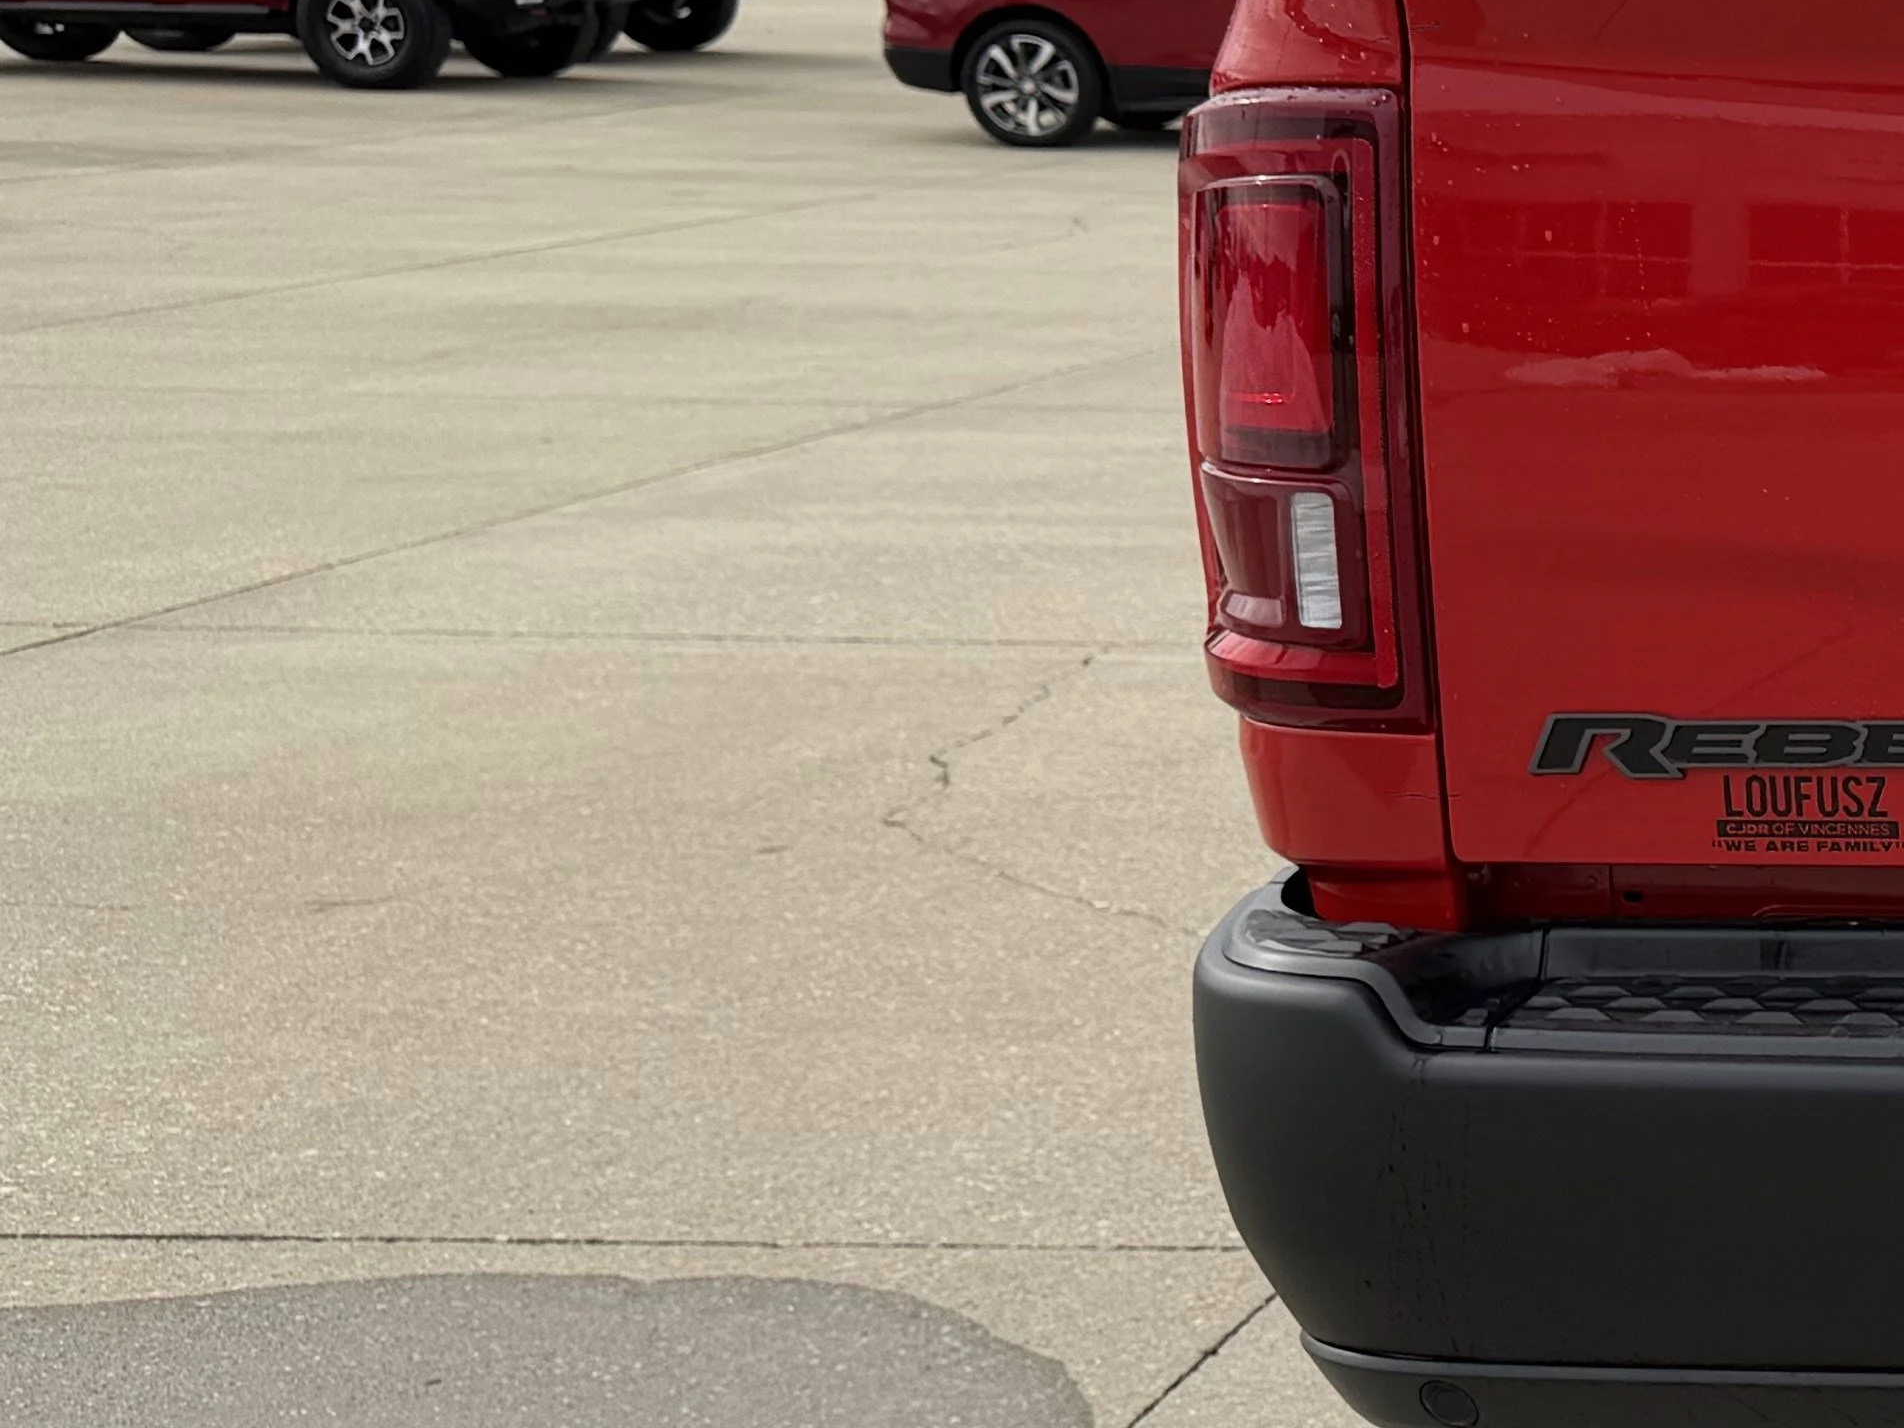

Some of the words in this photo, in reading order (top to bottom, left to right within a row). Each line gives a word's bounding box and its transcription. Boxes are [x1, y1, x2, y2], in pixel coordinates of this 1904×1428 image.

[1726, 823, 1768, 835] CJDR
[1772, 823, 1795, 835] OF
[1799, 823, 1891, 837] VINCENNES
[1765, 840, 1809, 853] ARE
